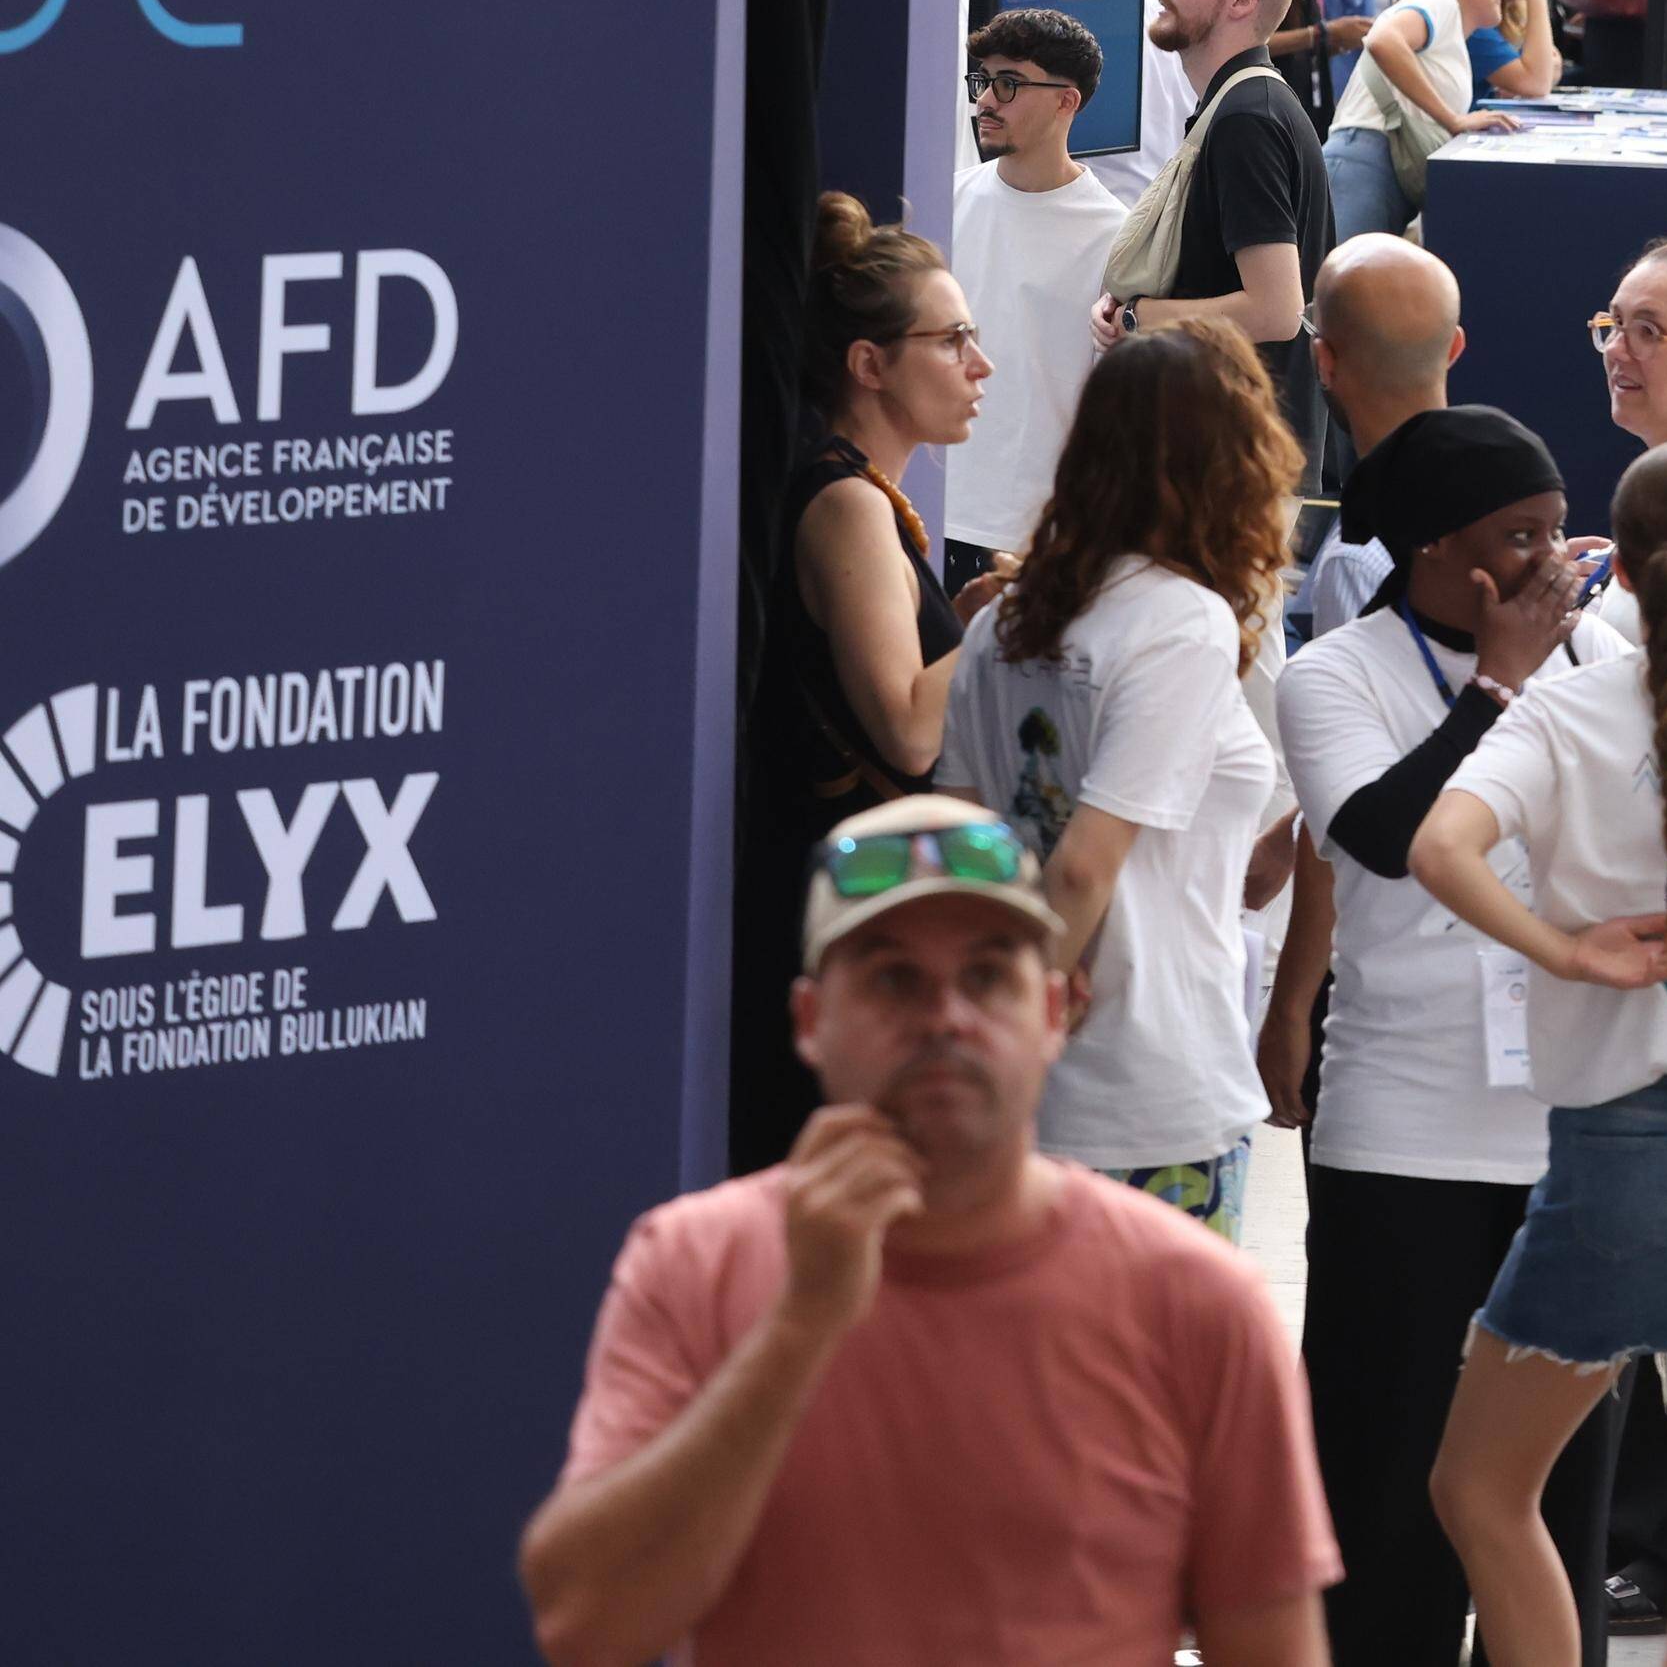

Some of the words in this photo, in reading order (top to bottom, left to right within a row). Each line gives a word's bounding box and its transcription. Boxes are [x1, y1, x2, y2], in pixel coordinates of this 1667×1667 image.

[126, 248, 459, 430] AFD
[123, 442, 262, 484] AGENCE
[273, 430, 454, 476] FRANÇAISE
[123, 497, 166, 534] DE
[177, 478, 453, 529] DÉVELOPPEMENT
[106, 684, 164, 762] LA
[182, 659, 445, 755] FONDATION
[81, 771, 440, 959] ELYX
[79, 1038, 113, 1081] LA
[122, 1017, 271, 1075] FONDATION
[280, 998, 427, 1056] BULLUKIAN
[80, 984, 155, 1034] SOUS
[166, 969, 263, 1023] L'ÉGIDE
[273, 967, 308, 1010] DE
